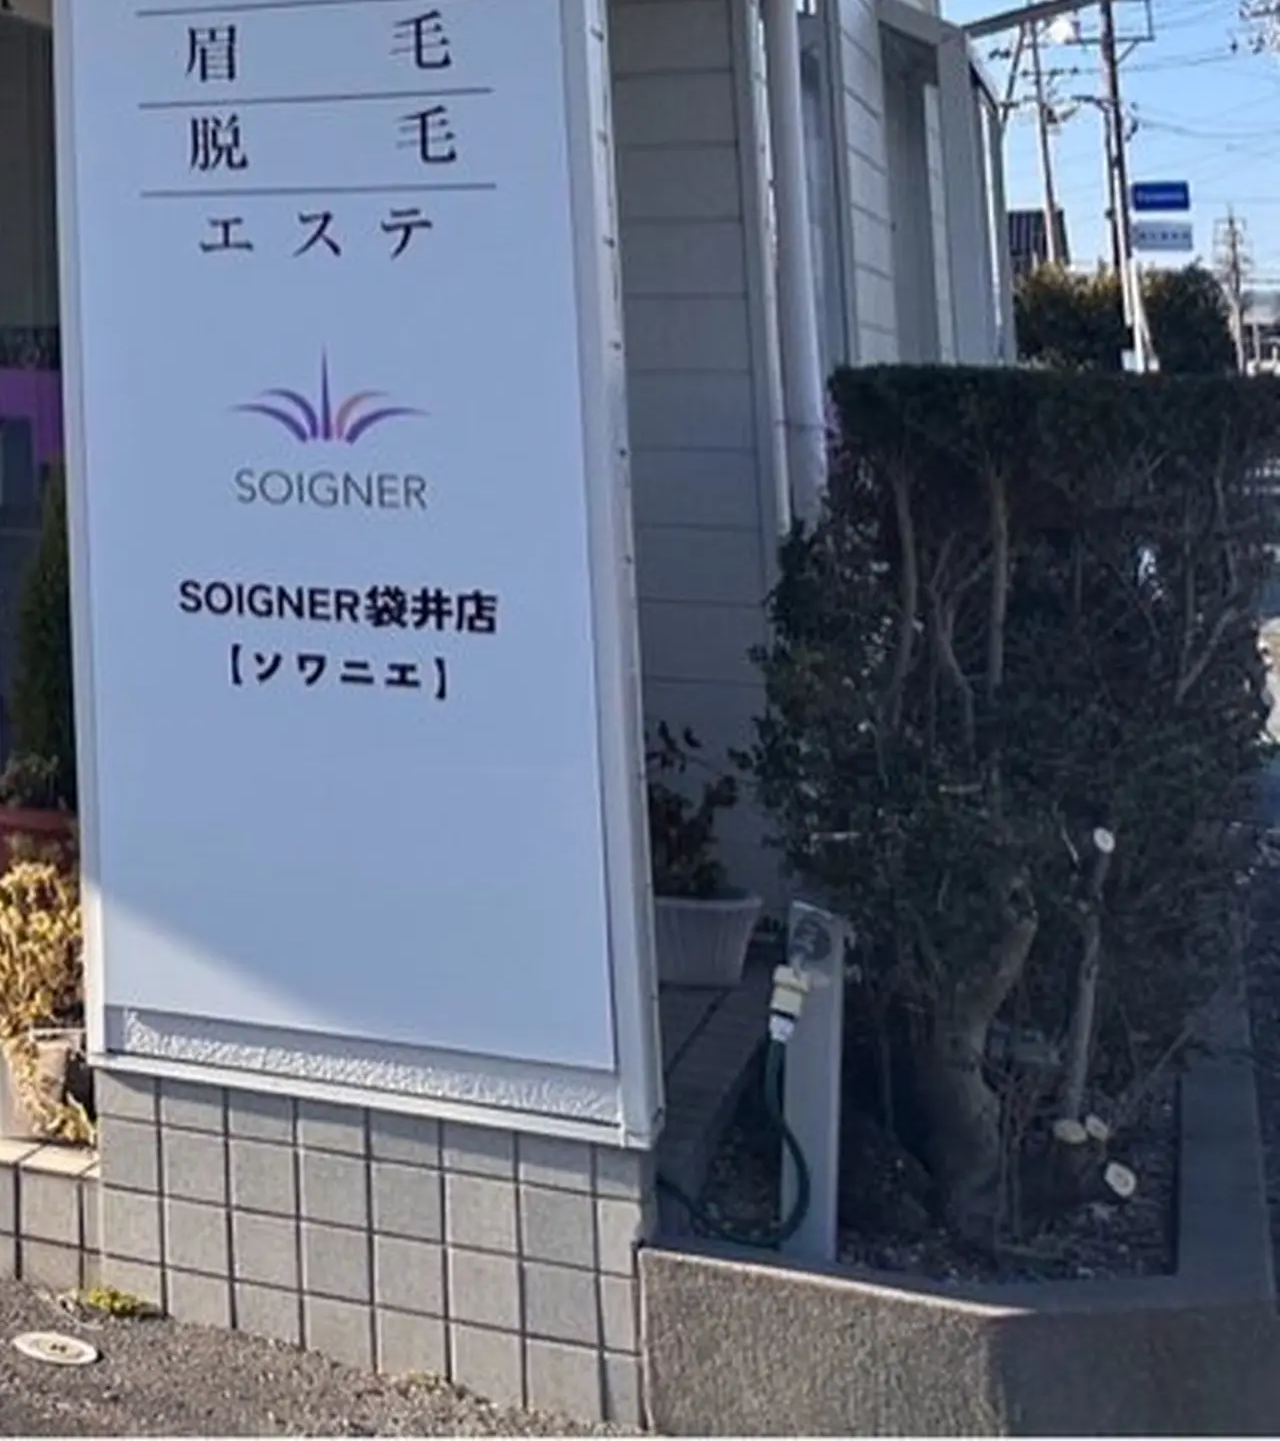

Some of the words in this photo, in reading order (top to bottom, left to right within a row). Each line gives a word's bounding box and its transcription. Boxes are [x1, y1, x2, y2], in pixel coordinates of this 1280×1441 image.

[184, 8, 454, 85] 眉毛
[188, 103, 459, 174] 脱毛
[197, 206, 435, 261] エステ
[233, 467, 428, 511] SOIGNER
[177, 577, 500, 637] SOIGNER袋井店
